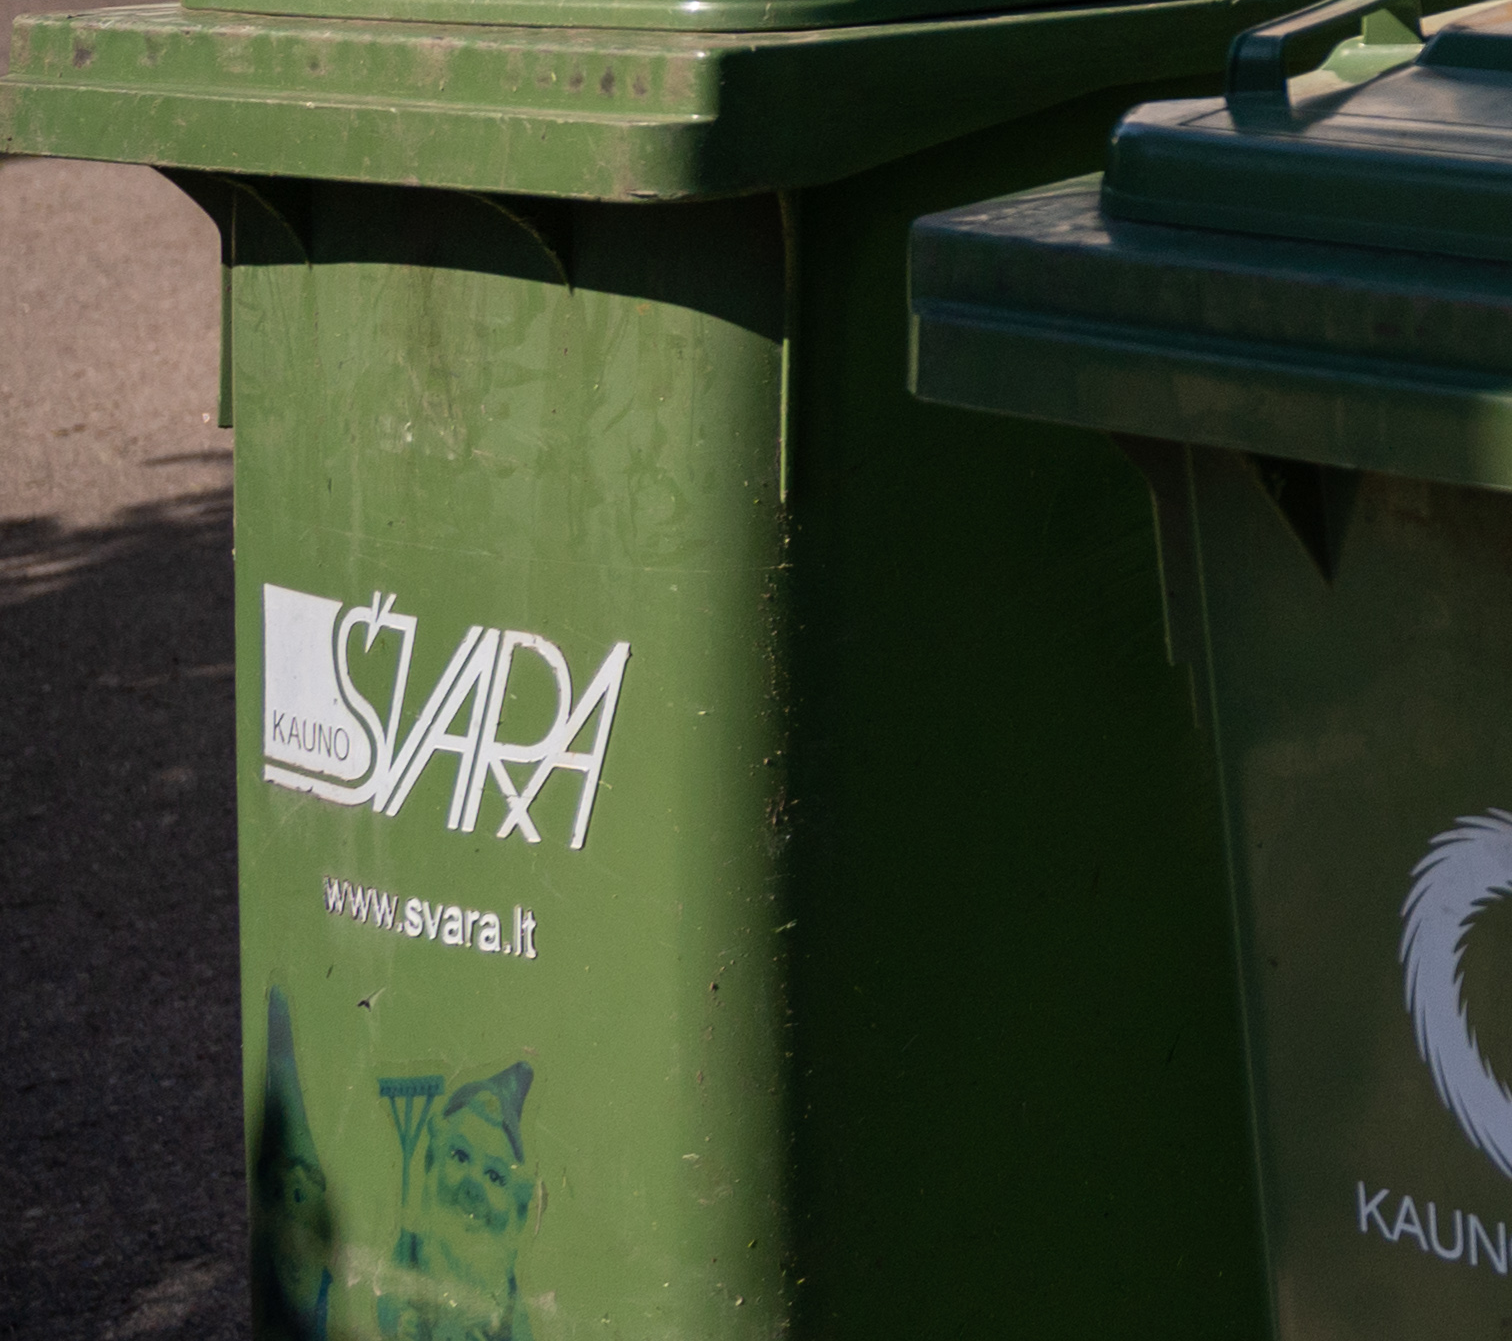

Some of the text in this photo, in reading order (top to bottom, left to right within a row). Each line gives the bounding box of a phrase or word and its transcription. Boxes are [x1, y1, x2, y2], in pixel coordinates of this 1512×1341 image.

[263, 591, 631, 852] ŠVARA
[271, 709, 352, 763] KAUNO
[322, 876, 538, 960] www.svara.lt
